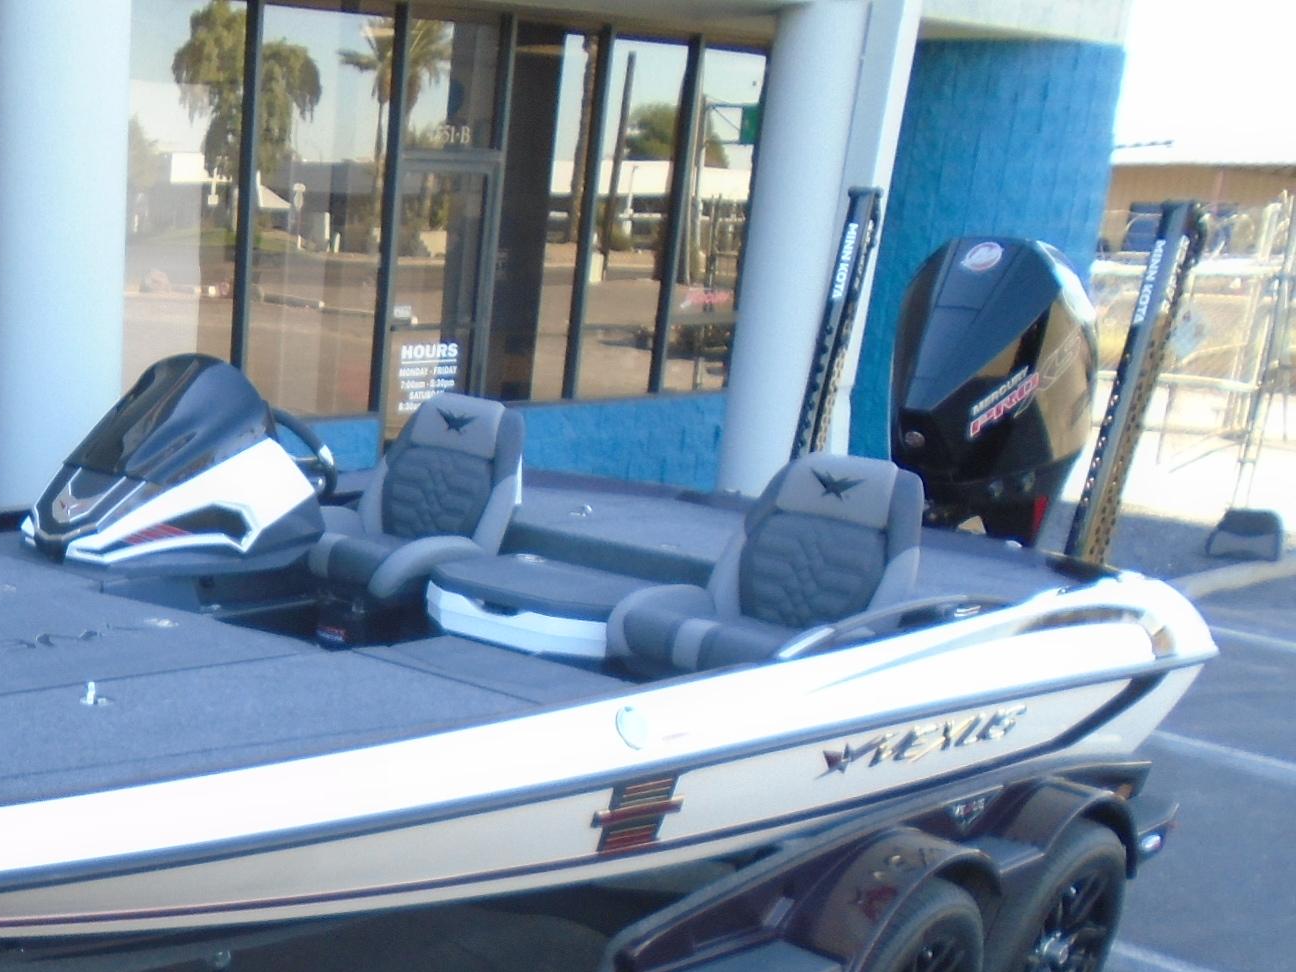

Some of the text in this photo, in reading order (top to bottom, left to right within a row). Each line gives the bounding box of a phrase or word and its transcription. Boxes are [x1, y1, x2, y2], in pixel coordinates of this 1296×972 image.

[832, 222, 859, 298] MINN KOTA
[1133, 239, 1167, 324] MINN KOTA
[399, 367, 428, 377] MONDAY
[433, 365, 457, 375] FRIDAY
[400, 343, 459, 359] HOURS
[972, 365, 1029, 415] MERCURY
